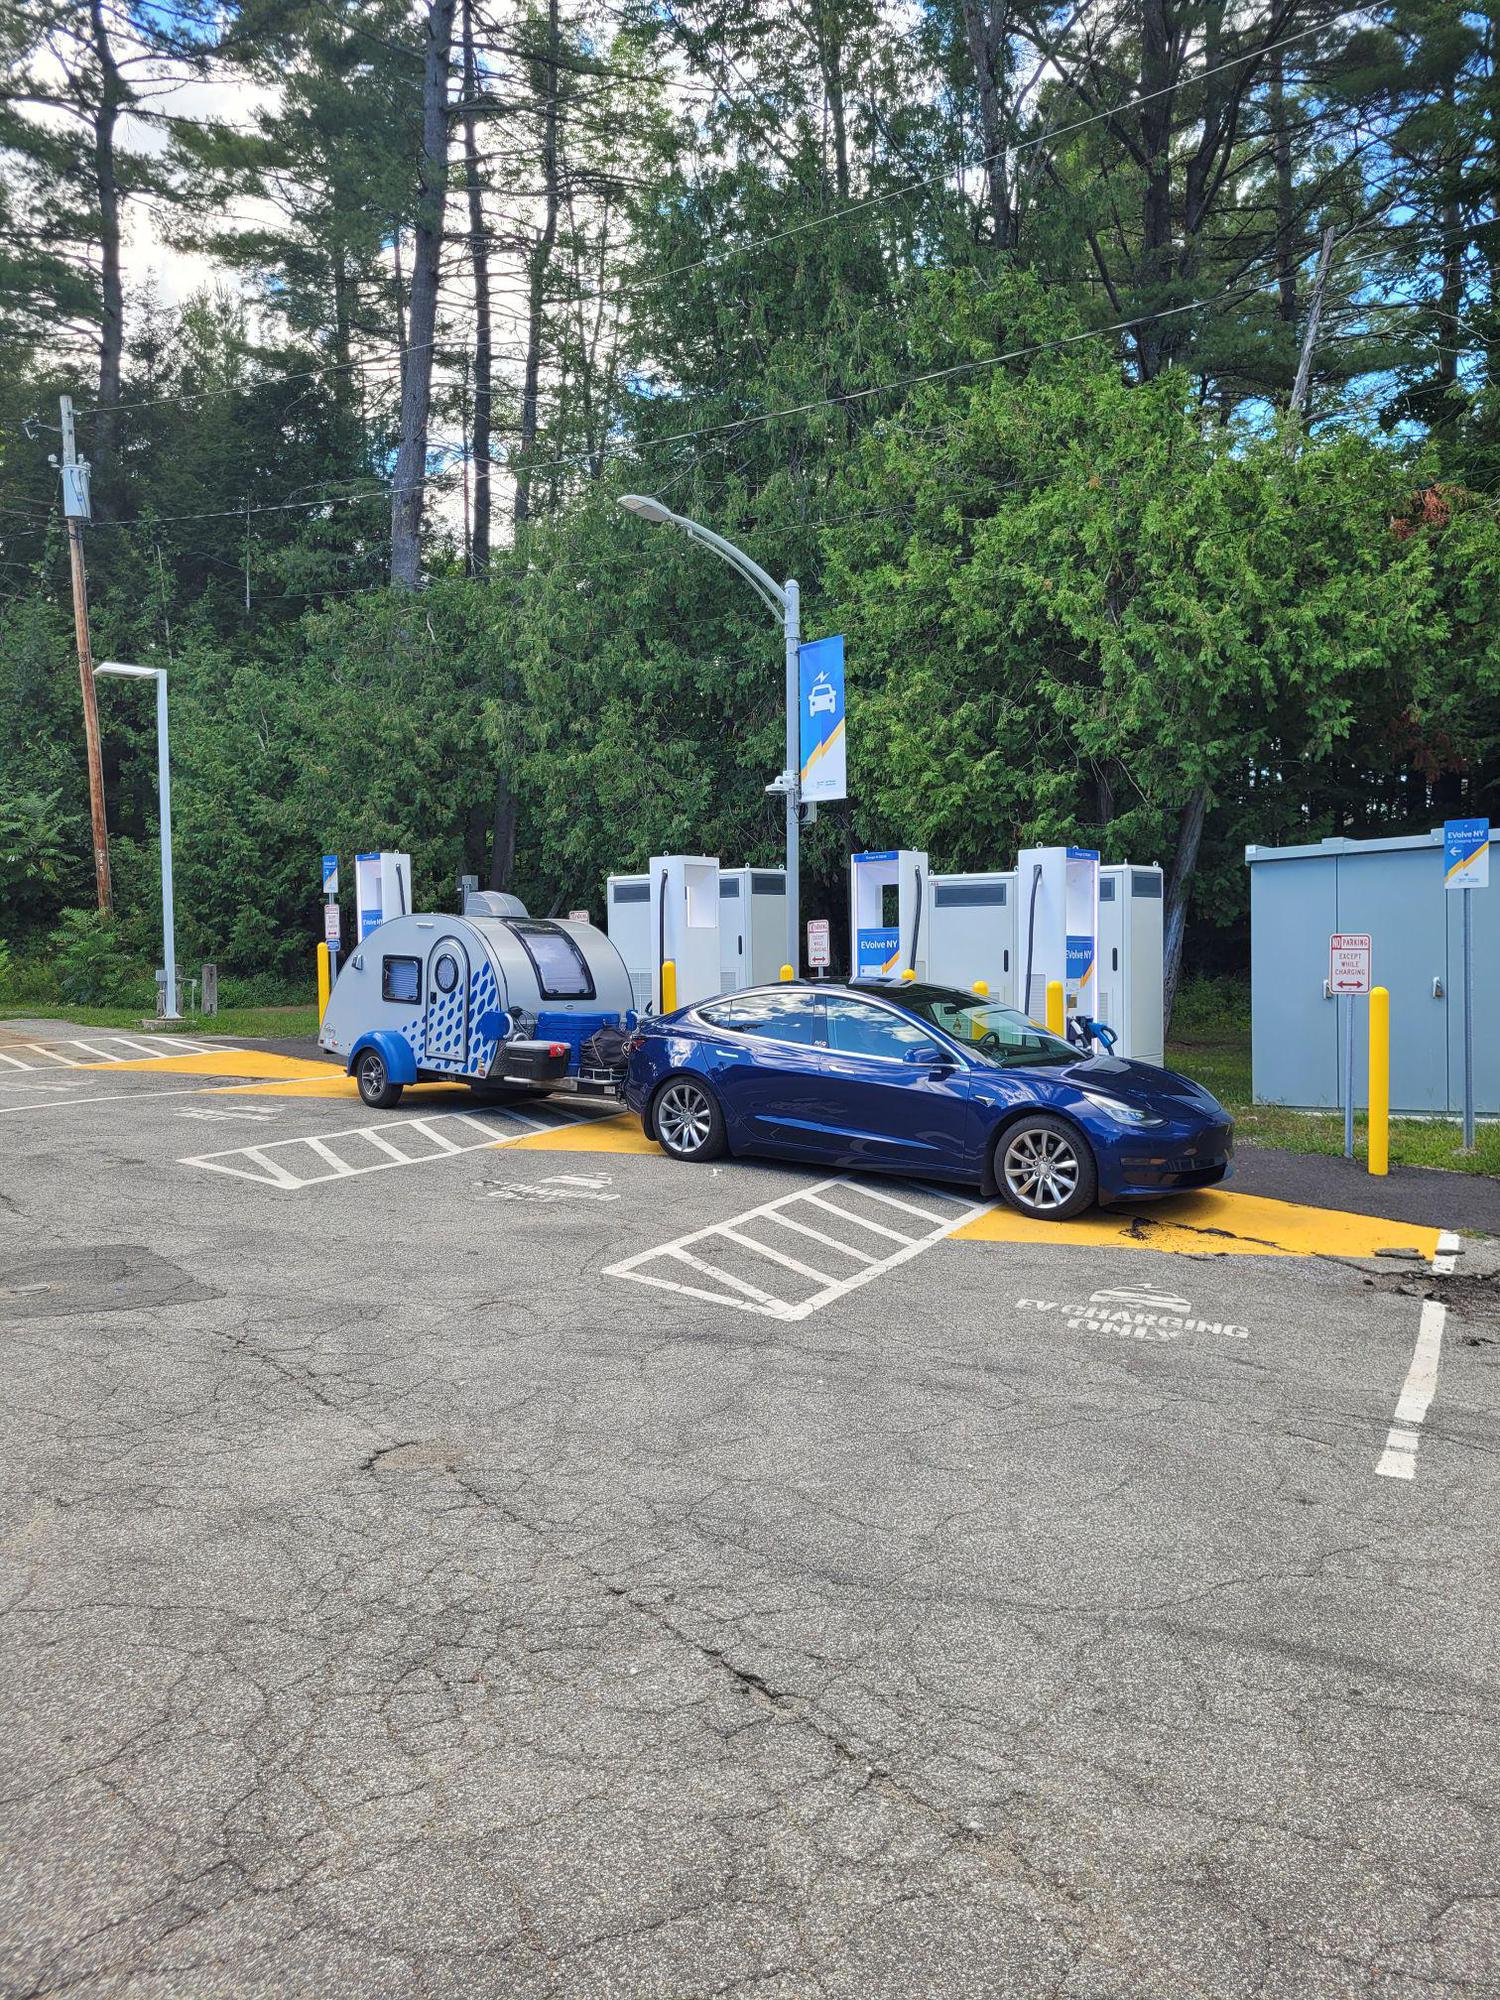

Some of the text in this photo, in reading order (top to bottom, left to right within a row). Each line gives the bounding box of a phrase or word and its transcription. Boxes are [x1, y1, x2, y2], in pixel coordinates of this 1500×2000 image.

[1447, 831, 1472, 839] EVolve
[860, 940, 898, 949] EVolve NY
[1343, 938, 1368, 947] PARKING
[1084, 950, 1092, 960] NY
[1335, 968, 1366, 976] CHARGING
[1014, 1298, 1250, 1339] EV CHARGING
[1067, 1318, 1185, 1341] ONLY
